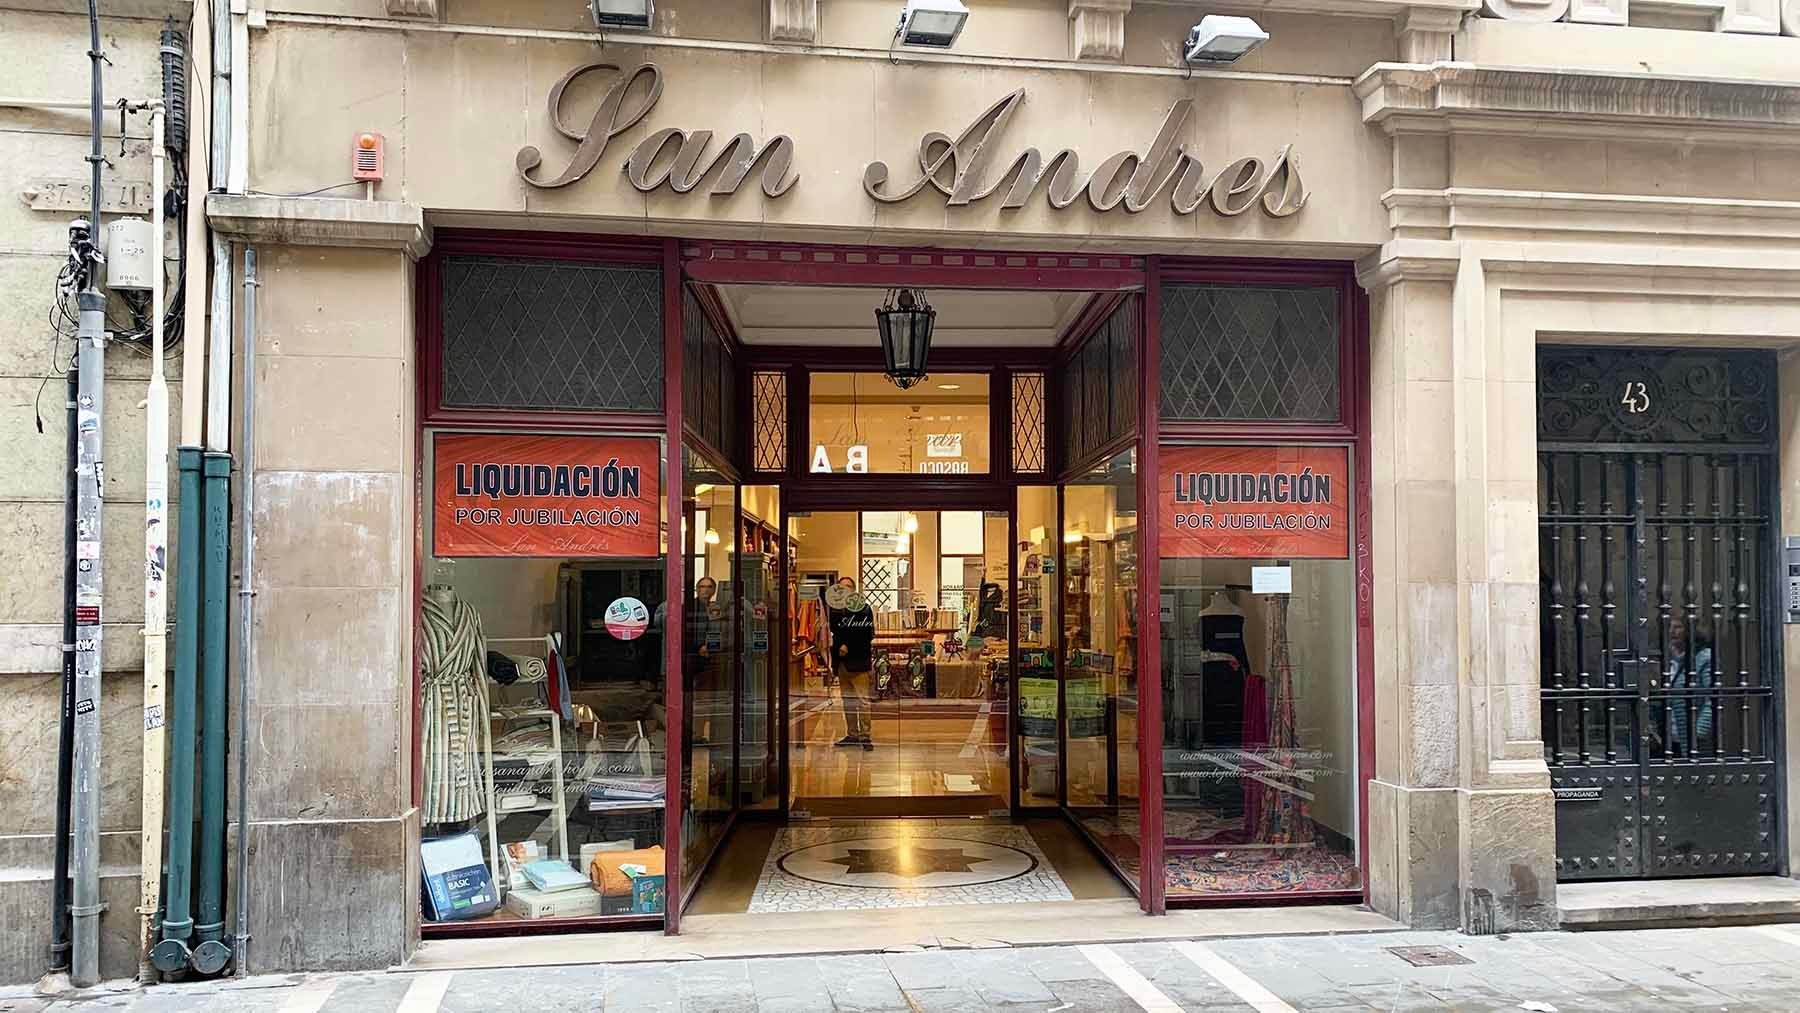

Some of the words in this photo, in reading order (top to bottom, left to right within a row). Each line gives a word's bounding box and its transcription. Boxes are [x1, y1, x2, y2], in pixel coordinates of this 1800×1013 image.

[516, 62, 800, 200] San
[863, 88, 1311, 218] Andres
[1621, 382, 1650, 413] 43
[455, 458, 640, 500] LIQUIDACIÓN
[1175, 468, 1331, 507] LIQUIDACIÓN
[455, 508, 502, 526] POR
[507, 505, 640, 526] JUBILACIÓN
[1175, 513, 1215, 530] POR
[1218, 512, 1332, 530] JUBILACIÓN
[448, 878, 470, 890] BASIC
